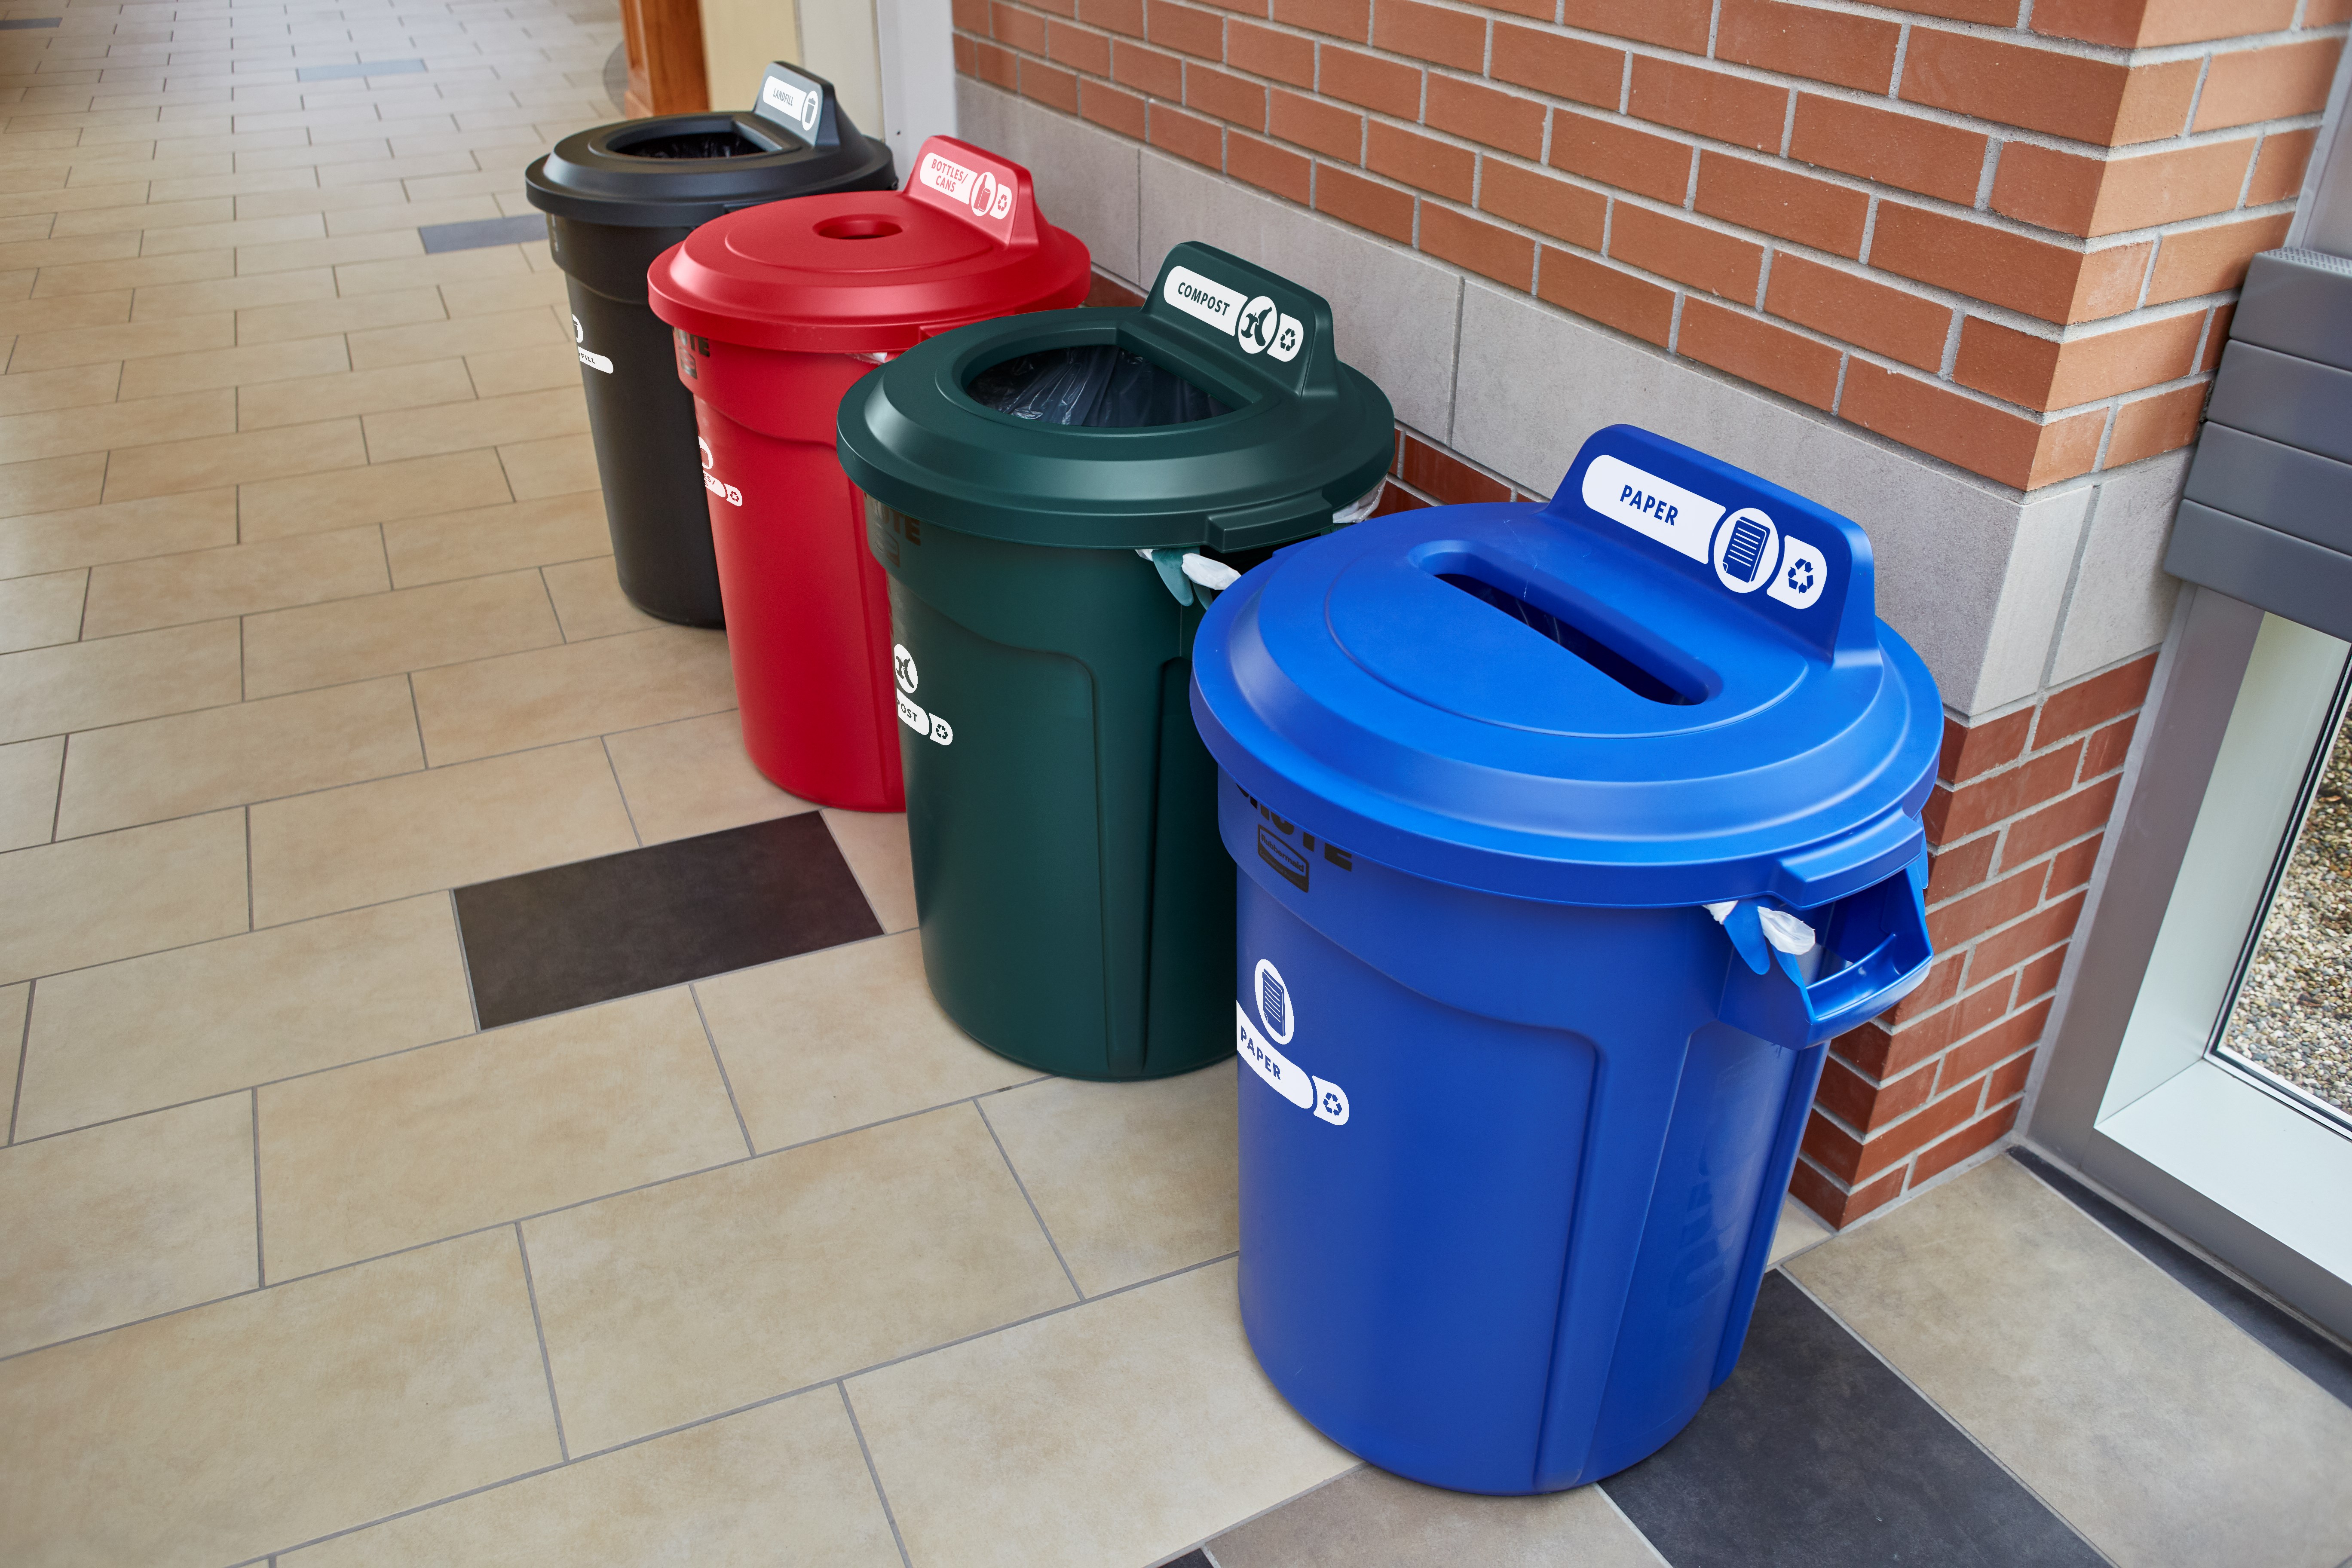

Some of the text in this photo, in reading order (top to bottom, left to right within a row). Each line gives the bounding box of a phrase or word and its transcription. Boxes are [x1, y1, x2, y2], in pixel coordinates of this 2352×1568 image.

[772, 88, 794, 106] LANDFILL
[931, 158, 968, 184] BOTTLES/
[935, 175, 956, 193] CANS
[1177, 282, 1230, 316] COMPOST
[579, 352, 596, 364] FILL
[1620, 484, 1678, 526] PAPER
[897, 698, 918, 722] POST
[1261, 833, 1305, 873] Rubbermaid
[1240, 1025, 1281, 1081] PAPER
